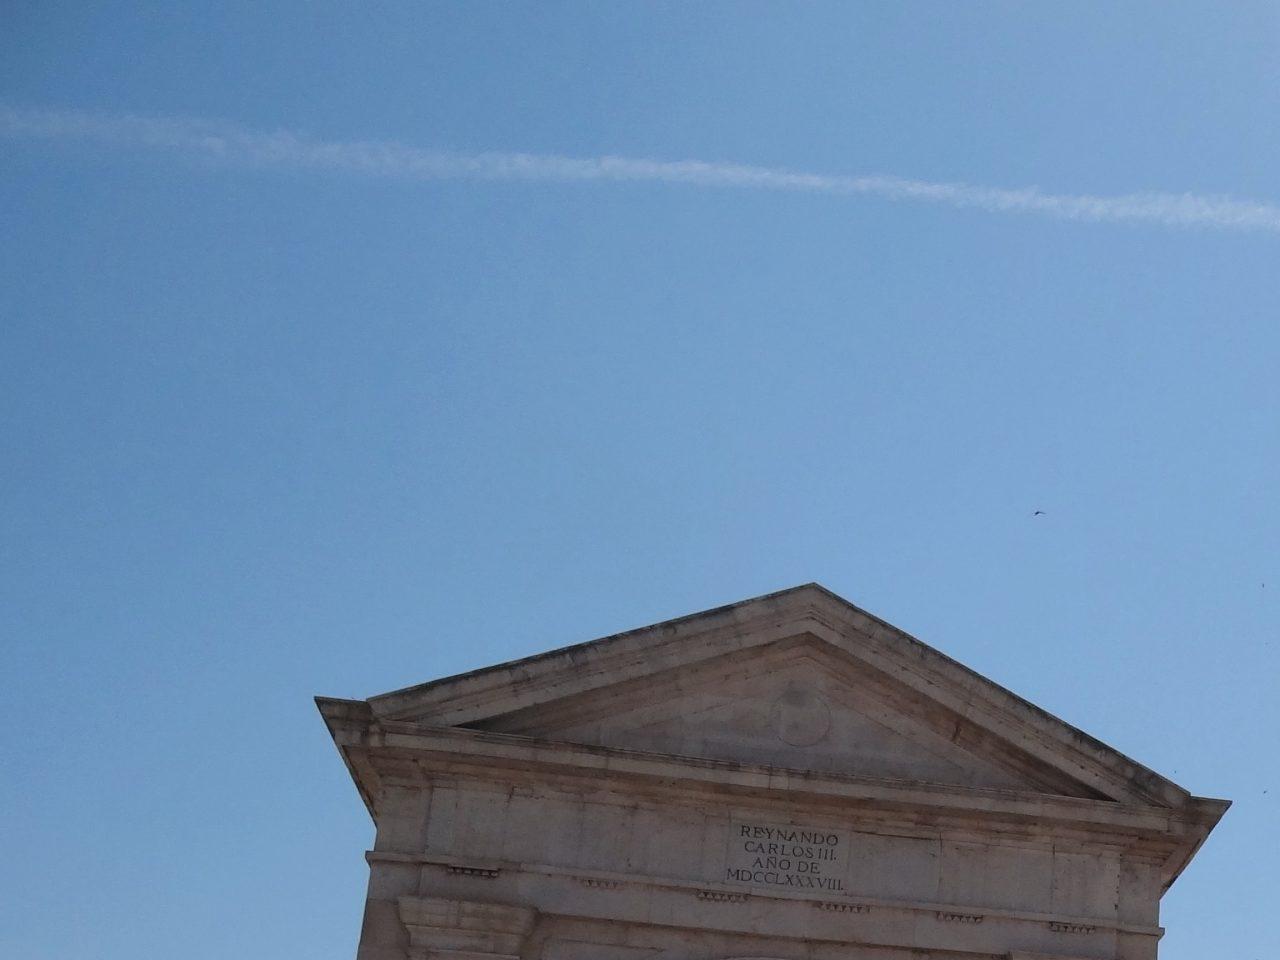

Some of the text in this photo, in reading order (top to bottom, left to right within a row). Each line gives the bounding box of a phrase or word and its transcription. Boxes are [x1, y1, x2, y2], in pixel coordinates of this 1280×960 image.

[740, 825, 839, 847] REYNANDO
[744, 841, 814, 859] CARLOS
[752, 857, 821, 874] AÑO DE
